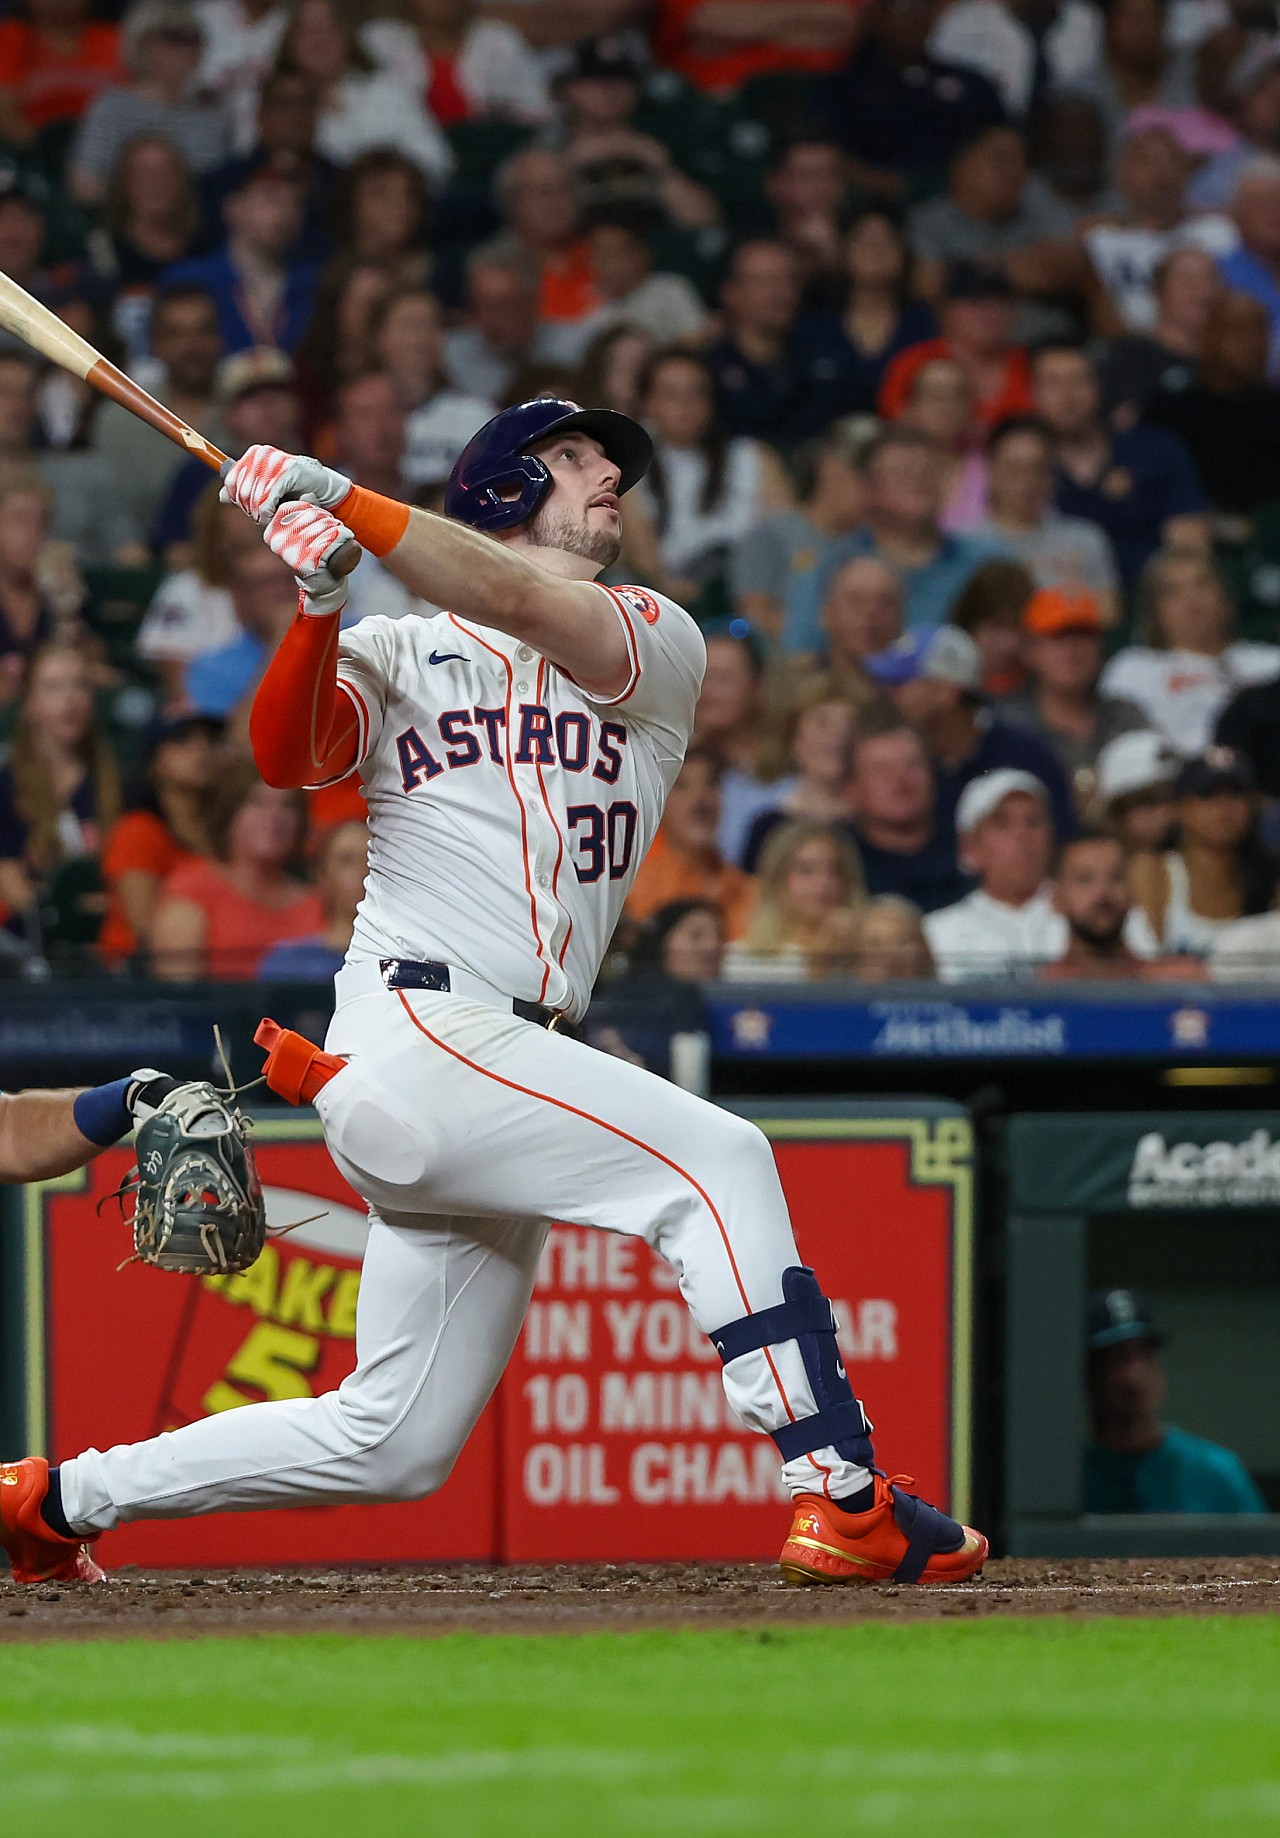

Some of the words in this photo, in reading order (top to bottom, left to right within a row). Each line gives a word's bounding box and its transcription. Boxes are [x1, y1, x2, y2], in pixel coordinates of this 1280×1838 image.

[396, 703, 628, 794] ASTROS
[566, 801, 638, 884] 30
[203, 1243, 361, 1339] AKE
[535, 1227, 640, 1293] THE
[202, 1320, 320, 1415] 5
[525, 1301, 593, 1363] IN
[605, 1300, 724, 1363] YOU
[834, 1299, 899, 1363] AR
[525, 1374, 590, 1435] 10
[525, 1443, 618, 1507] OIL
[631, 1443, 791, 1506] CHAN
